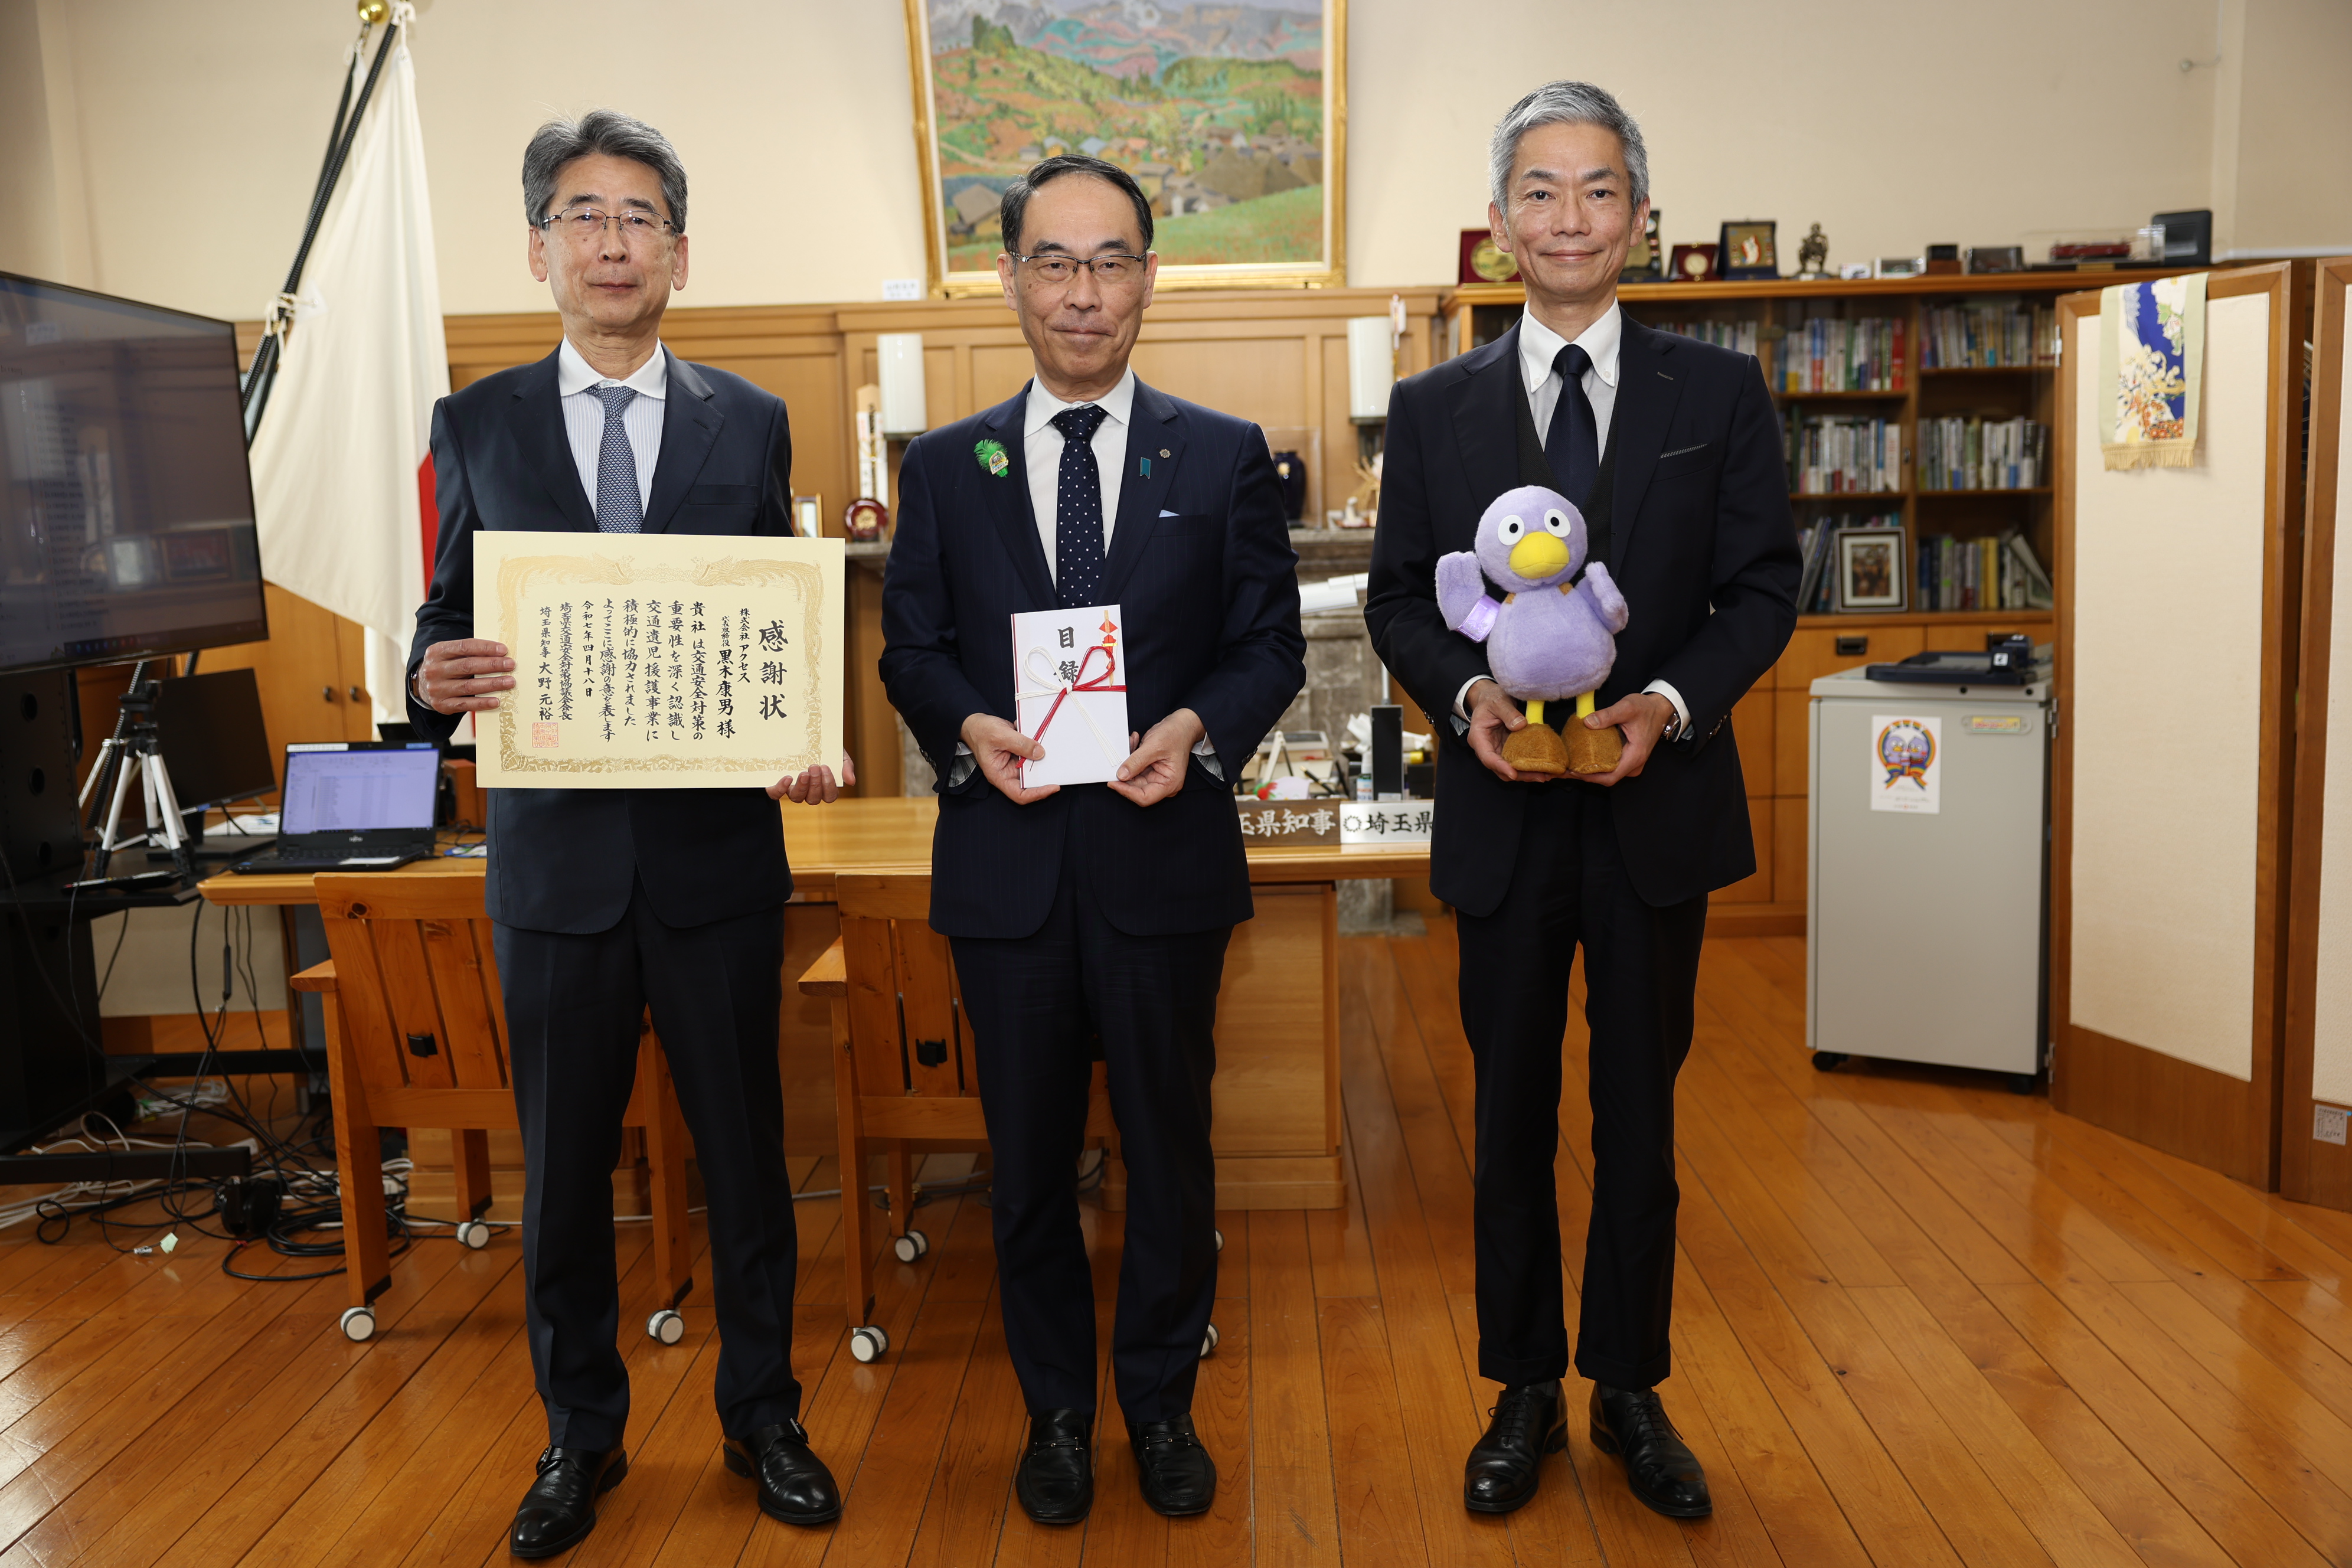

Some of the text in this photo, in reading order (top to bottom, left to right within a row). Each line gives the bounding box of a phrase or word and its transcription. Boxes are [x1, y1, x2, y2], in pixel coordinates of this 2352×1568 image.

[557, 602, 574, 720] 埼玉県交通安全対策協議会会長
[582, 600, 595, 698] 令和七年四月十八日
[598, 598, 616, 743] よってここに感謝の意を表します
[622, 599, 639, 726] 積極的に協力されました
[644, 599, 662, 742] 交通遺児援護事業に
[667, 600, 685, 740] 重要性を深く認識し
[758, 619, 789, 721] 感謝状
[1053, 626, 1079, 683] 目録
[1365, 811, 1432, 835] 埼玉県
